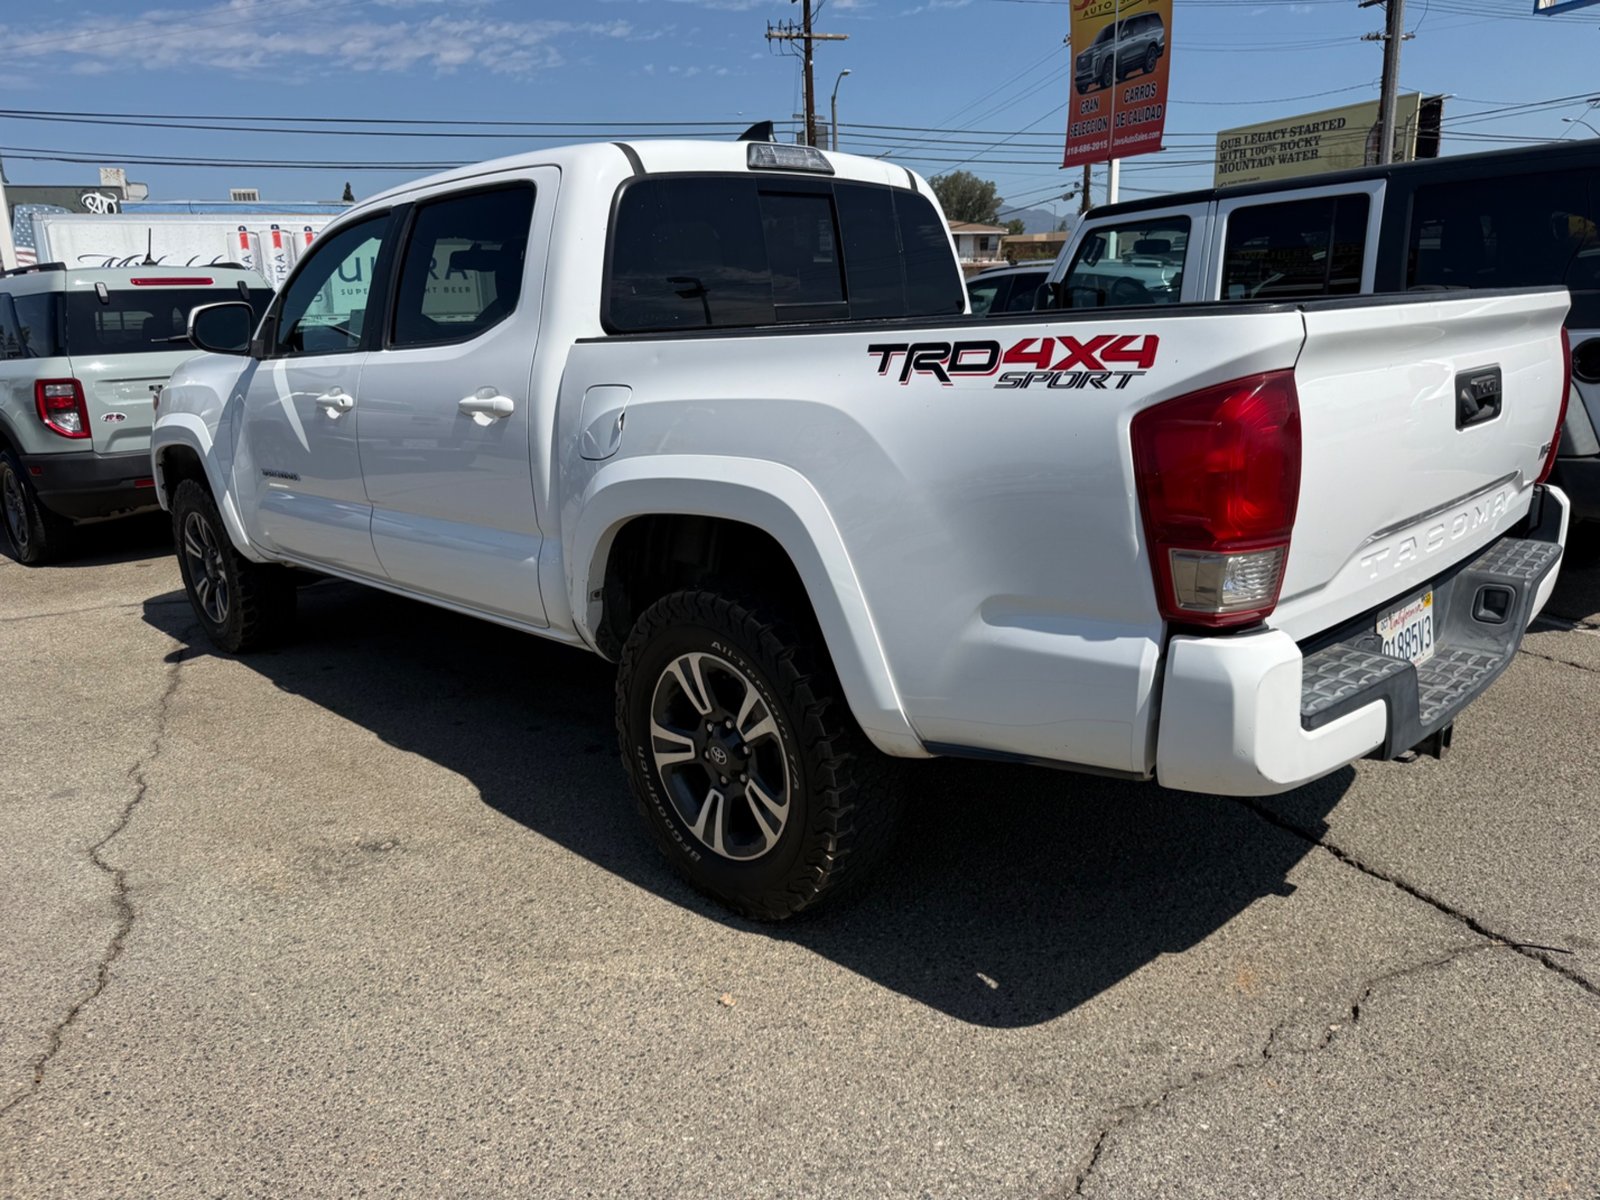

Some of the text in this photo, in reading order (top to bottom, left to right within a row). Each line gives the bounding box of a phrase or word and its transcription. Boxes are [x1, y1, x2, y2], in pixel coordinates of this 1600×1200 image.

[1083, 1, 1112, 17] AUTO
[1124, 82, 1157, 103] CARROS
[1080, 97, 1099, 115] GRAN
[1115, 105, 1163, 127] DE CALIDAD
[1220, 117, 1346, 150] OUR LEGACY STARTED
[1219, 135, 1321, 162] WITH 100% ROCKY
[1218, 155, 1276, 175] MOUNTAIN
[867, 340, 1003, 387] TRD
[993, 370, 1147, 389] SPORT
[1361, 490, 1509, 580] TACOMA
